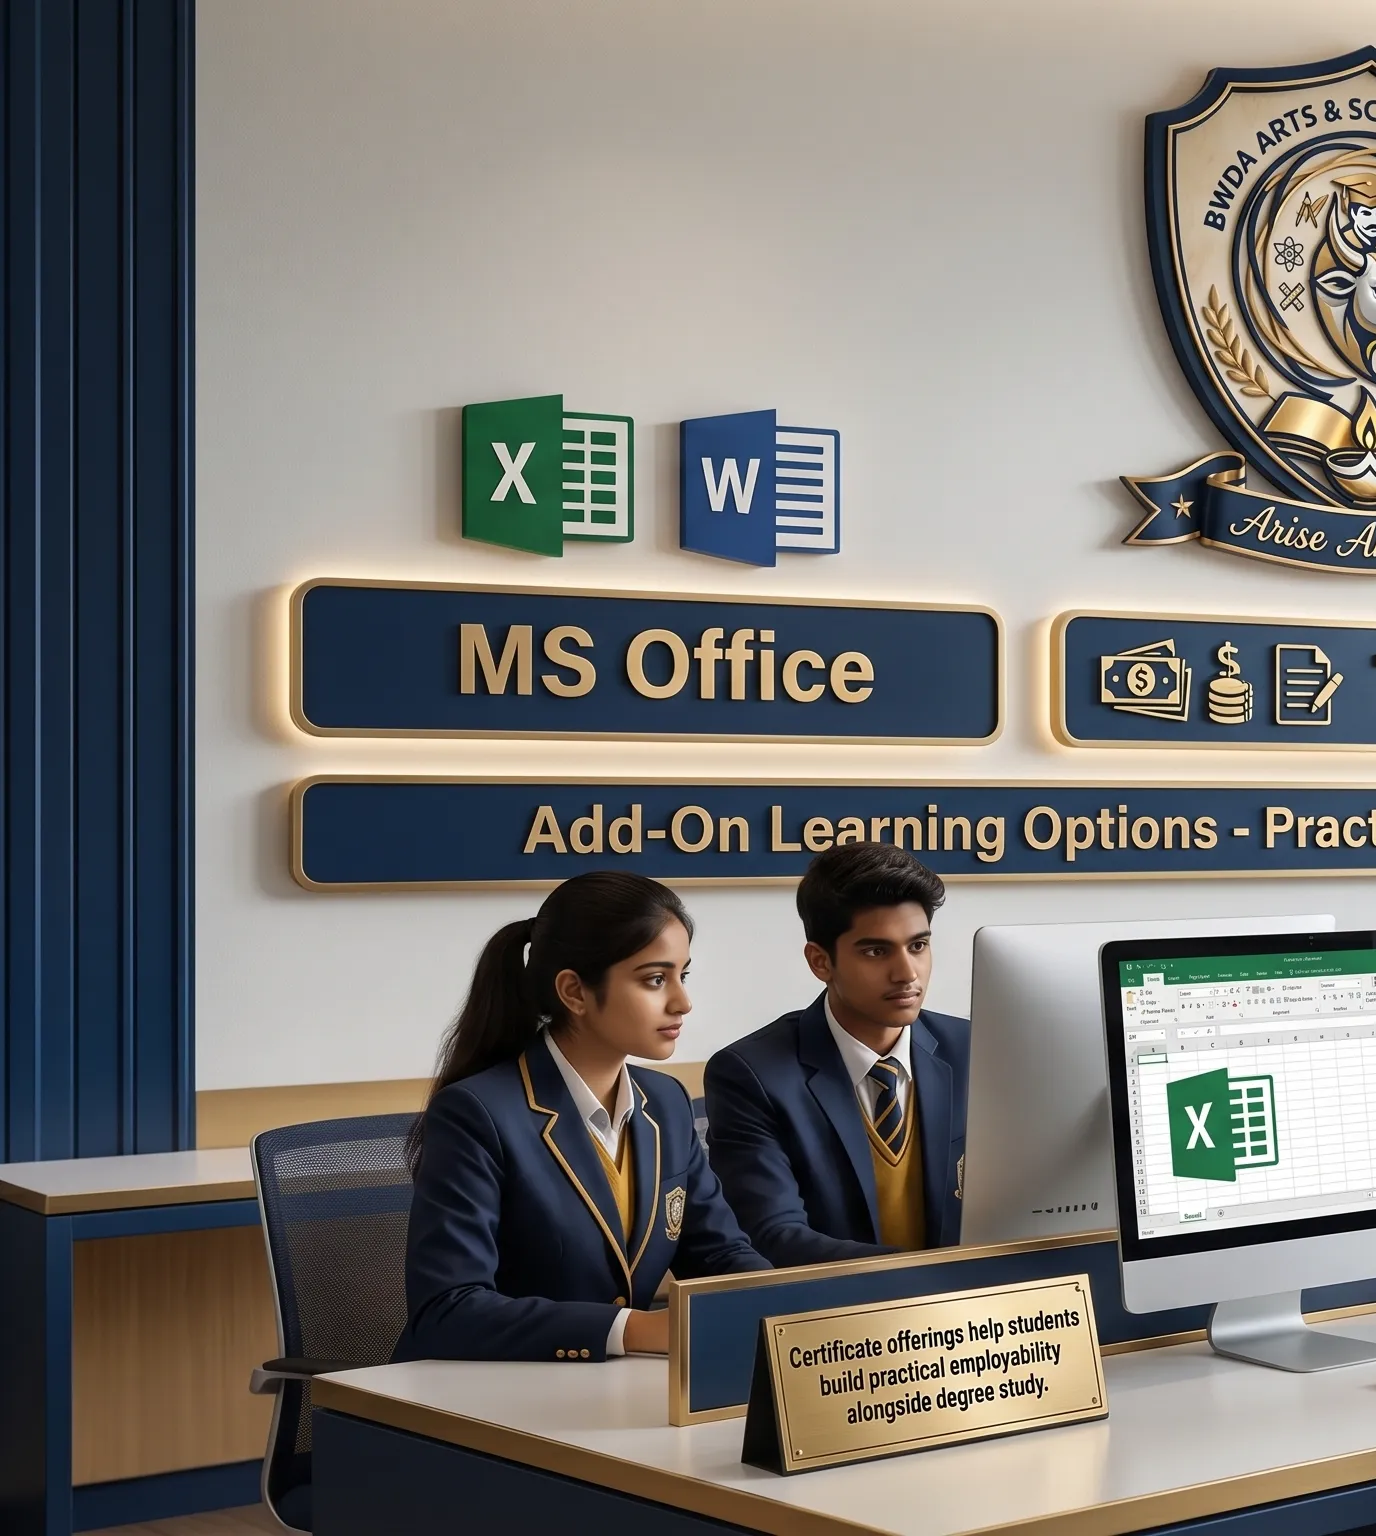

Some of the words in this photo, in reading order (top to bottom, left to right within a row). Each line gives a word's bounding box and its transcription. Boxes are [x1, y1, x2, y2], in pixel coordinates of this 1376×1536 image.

[1204, 150, 1258, 231] BWDA
[1256, 105, 1317, 155] ARTS
[1324, 100, 1342, 122] &
[490, 442, 537, 505] X
[702, 457, 760, 514] W
[1229, 506, 1328, 552] Arise
[459, 622, 597, 698] MS
[625, 626, 875, 704] Office
[523, 803, 750, 854] Add-On
[771, 804, 1005, 863] Learning
[1024, 805, 1218, 862] Options
[1233, 827, 1251, 837] -
[1183, 1101, 1216, 1150] X
[789, 1335, 882, 1369] Certificate
[887, 1324, 964, 1354] offerings
[968, 1318, 1004, 1344] help
[1008, 1308, 1080, 1336] students
[819, 1372, 865, 1396] build
[870, 1361, 945, 1394] practical
[950, 1342, 1061, 1379] employability
[847, 1395, 932, 1424] alongside
[937, 1384, 995, 1412] degree
[999, 1374, 1049, 1402] study.
